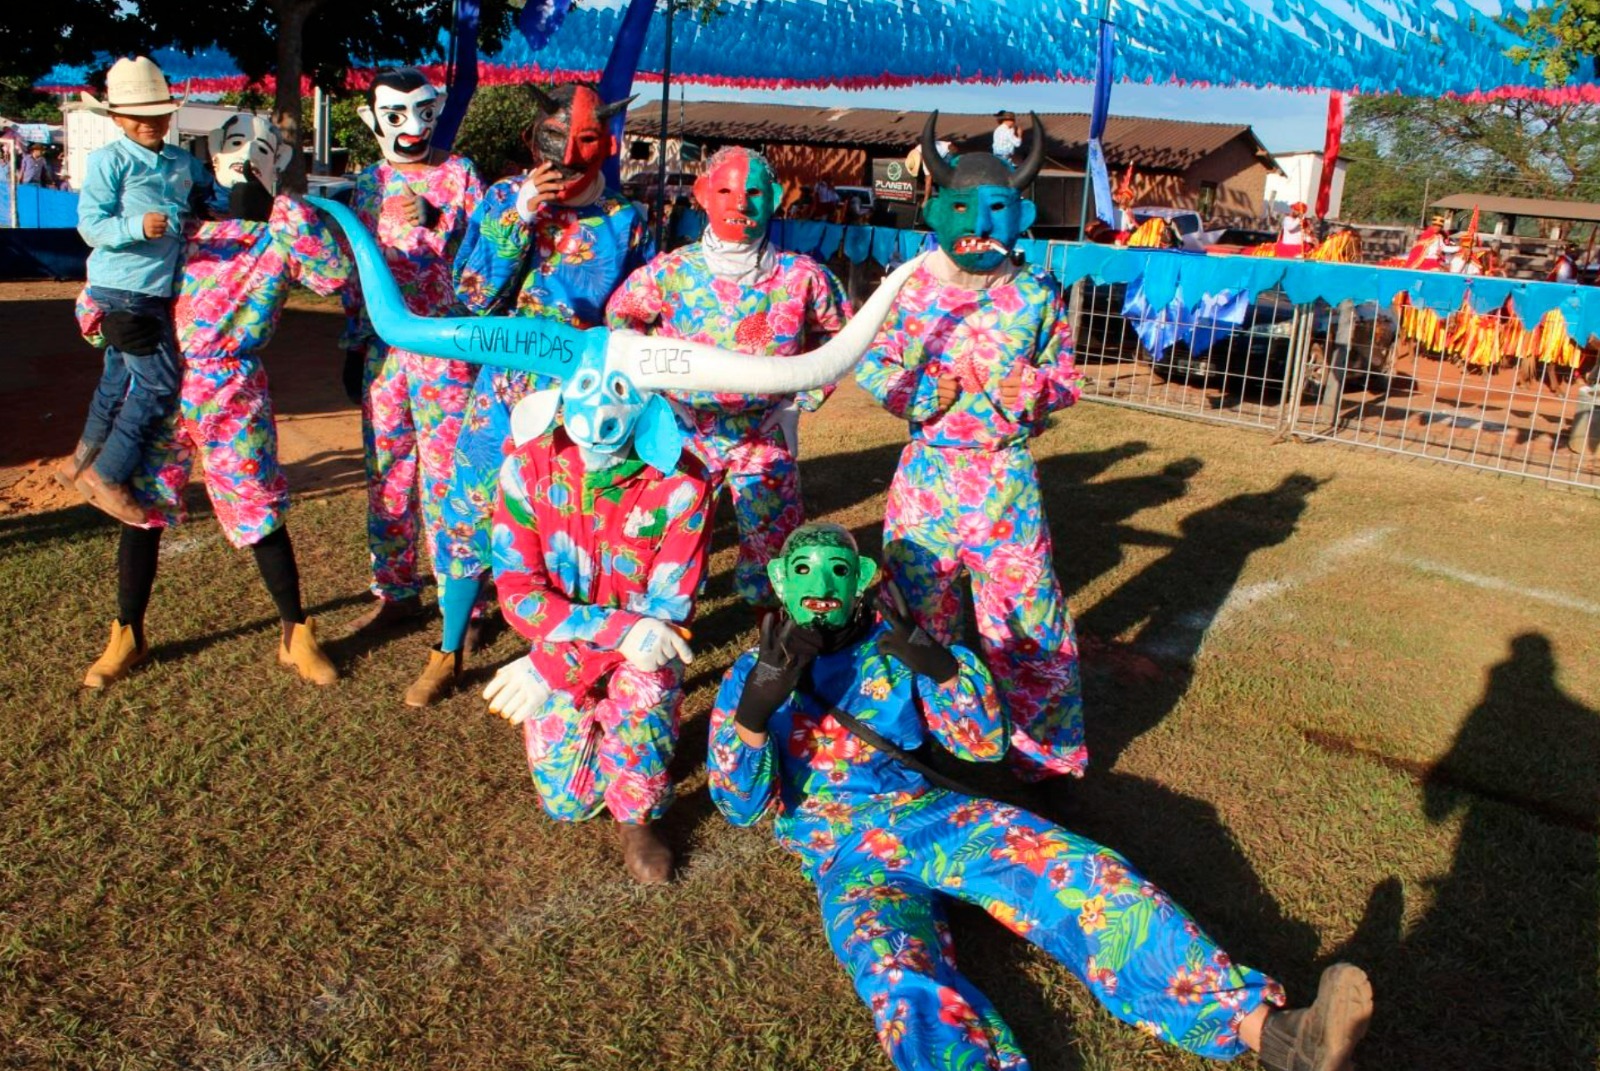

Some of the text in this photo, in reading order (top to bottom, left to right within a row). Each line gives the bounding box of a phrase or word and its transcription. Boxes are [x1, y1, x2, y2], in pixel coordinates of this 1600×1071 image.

[875, 180, 913, 191] PLANETA
[454, 324, 574, 364] CAVALHADAS
[639, 348, 692, 375] 2025
